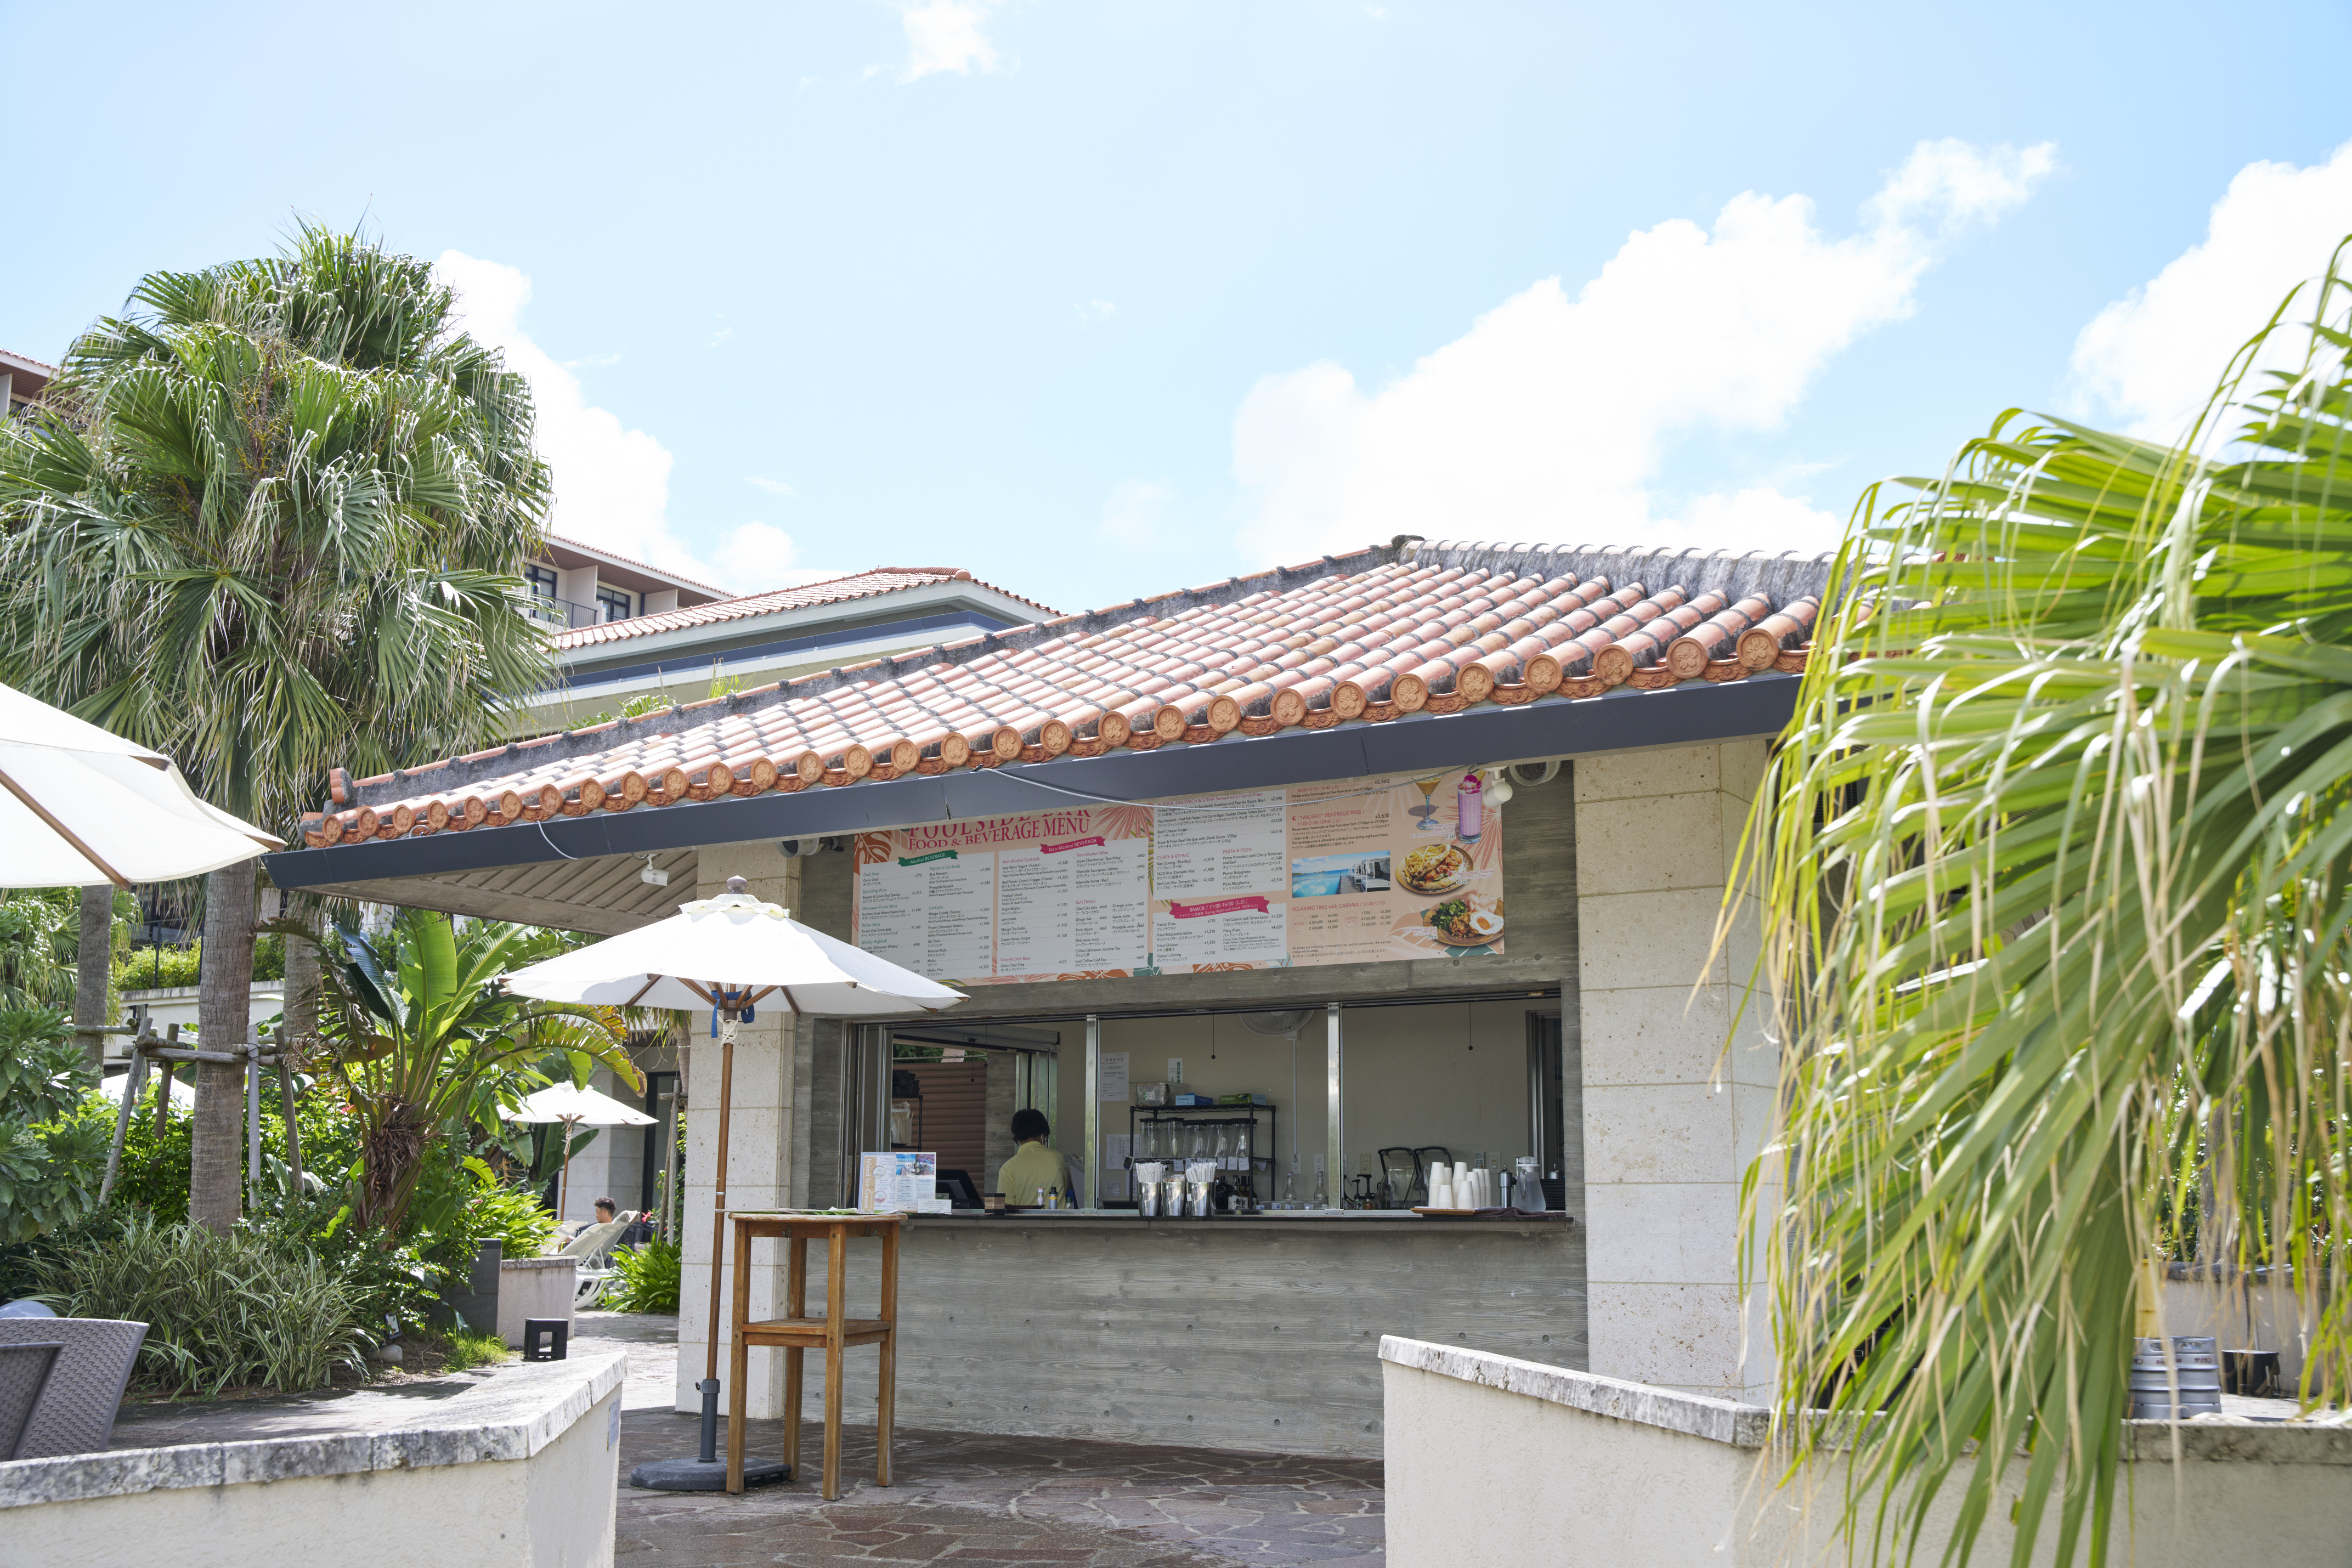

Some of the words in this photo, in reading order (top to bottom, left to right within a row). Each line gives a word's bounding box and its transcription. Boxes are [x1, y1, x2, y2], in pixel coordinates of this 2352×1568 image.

[908, 838, 948, 850] FOOD
[965, 820, 1040, 845] BEVERAGE
[1043, 818, 1090, 837] MENU
[1049, 844, 1073, 852] Non-Alcohol
[1074, 838, 1096, 847] BEVERAGE
[925, 852, 946, 861] BEVERAGE
